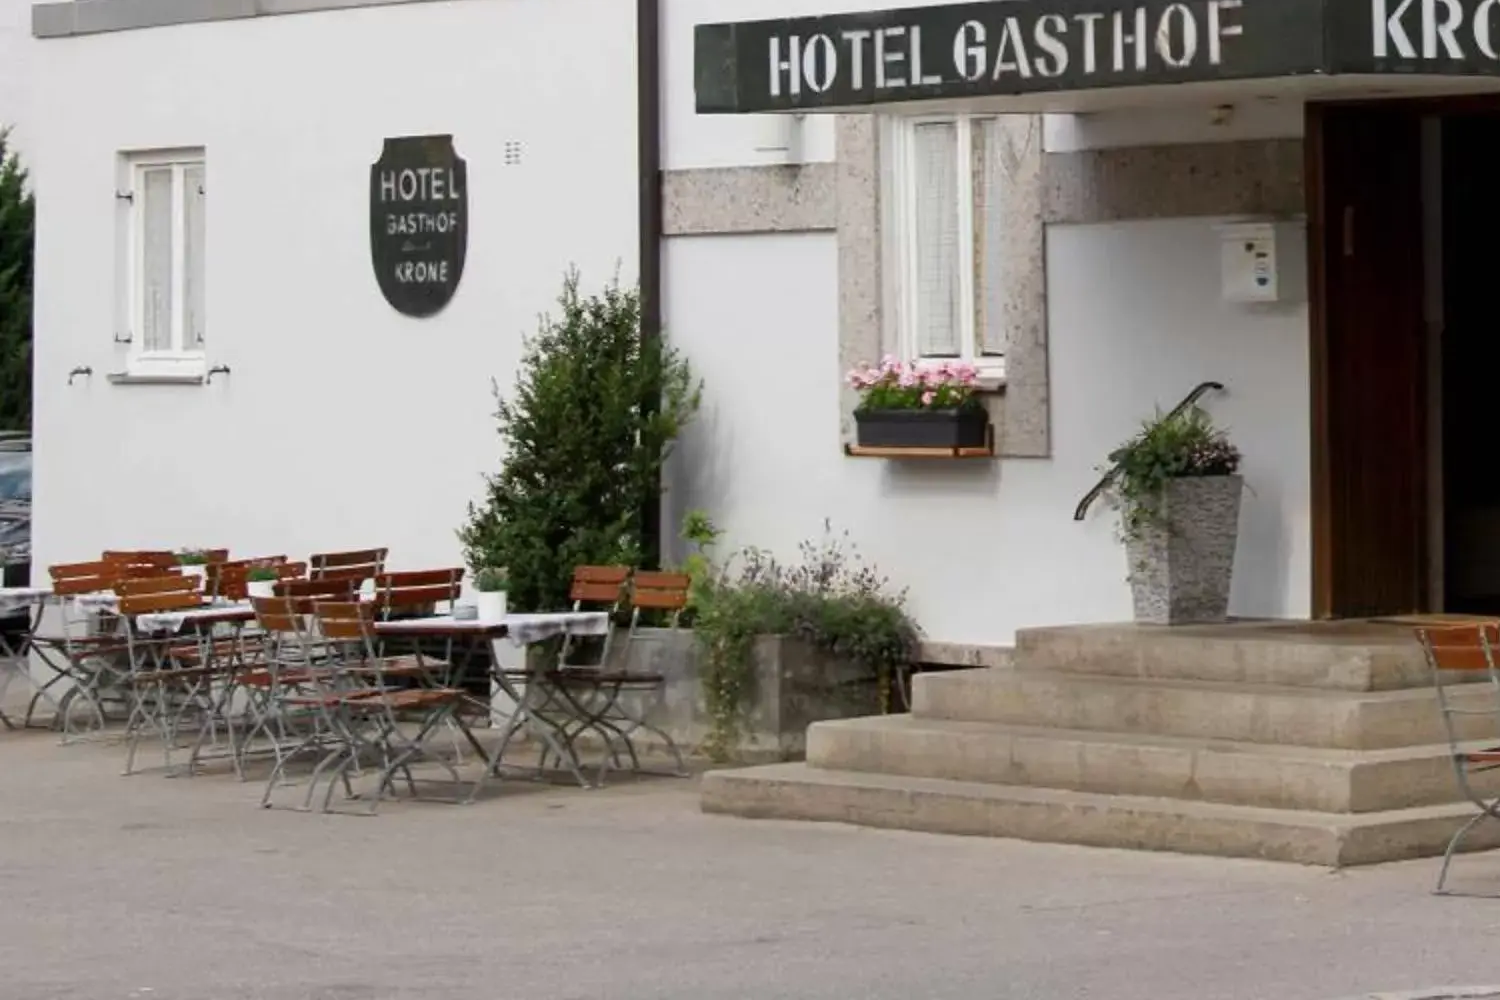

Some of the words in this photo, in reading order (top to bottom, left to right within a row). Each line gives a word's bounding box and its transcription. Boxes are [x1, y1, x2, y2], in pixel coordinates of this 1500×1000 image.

[769, 25, 942, 97] HOTEL
[952, 0, 1244, 82] GASTHOF
[380, 167, 460, 202] HOTEL
[387, 211, 458, 236] GASTHOF
[395, 260, 449, 283] KRONE
